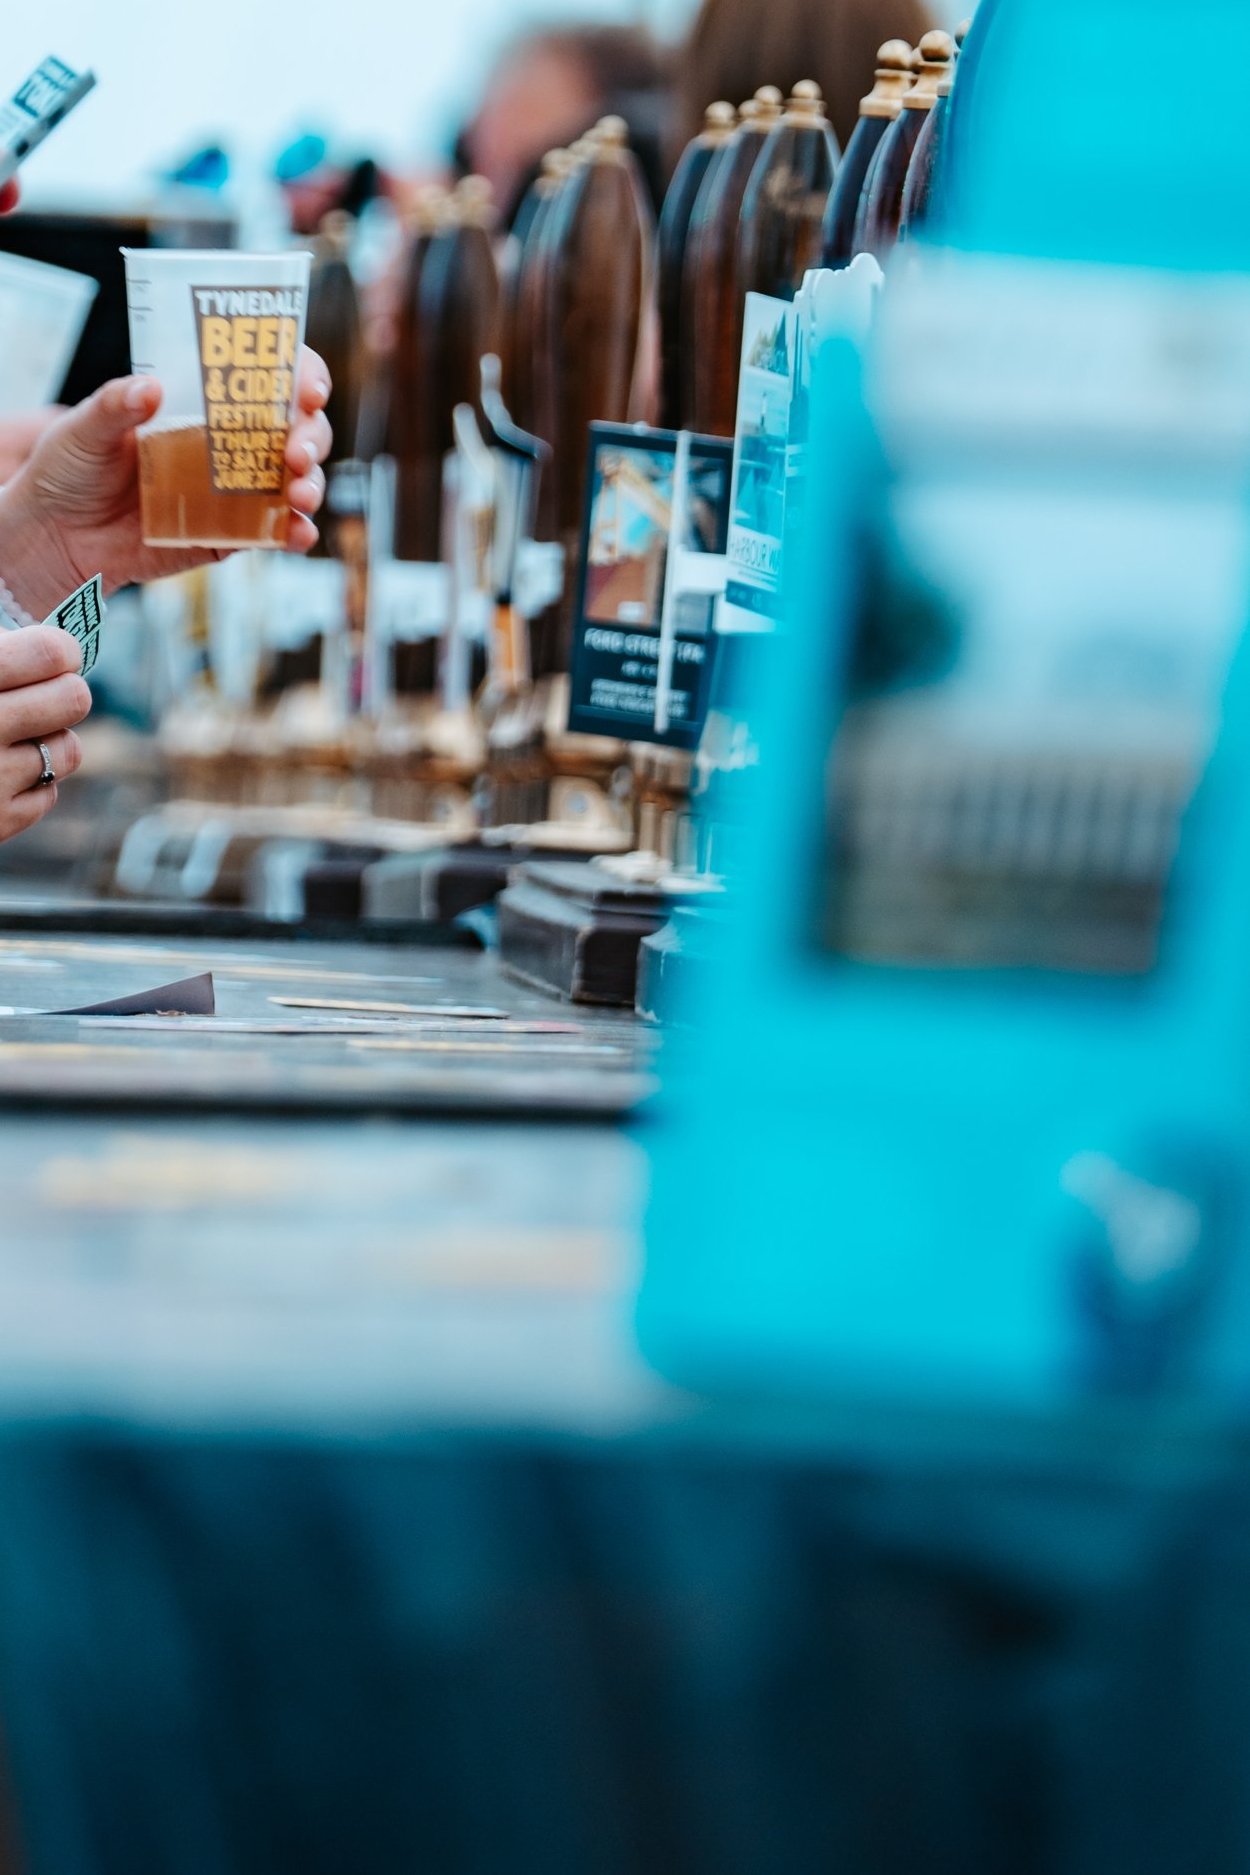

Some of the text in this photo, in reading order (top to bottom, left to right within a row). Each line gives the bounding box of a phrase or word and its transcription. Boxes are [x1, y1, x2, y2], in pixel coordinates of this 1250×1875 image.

[194, 289, 303, 316] TYNEDALE
[202, 316, 297, 367] BEER
[205, 368, 293, 403] & CIDER
[83, 583, 99, 630] DRINK
